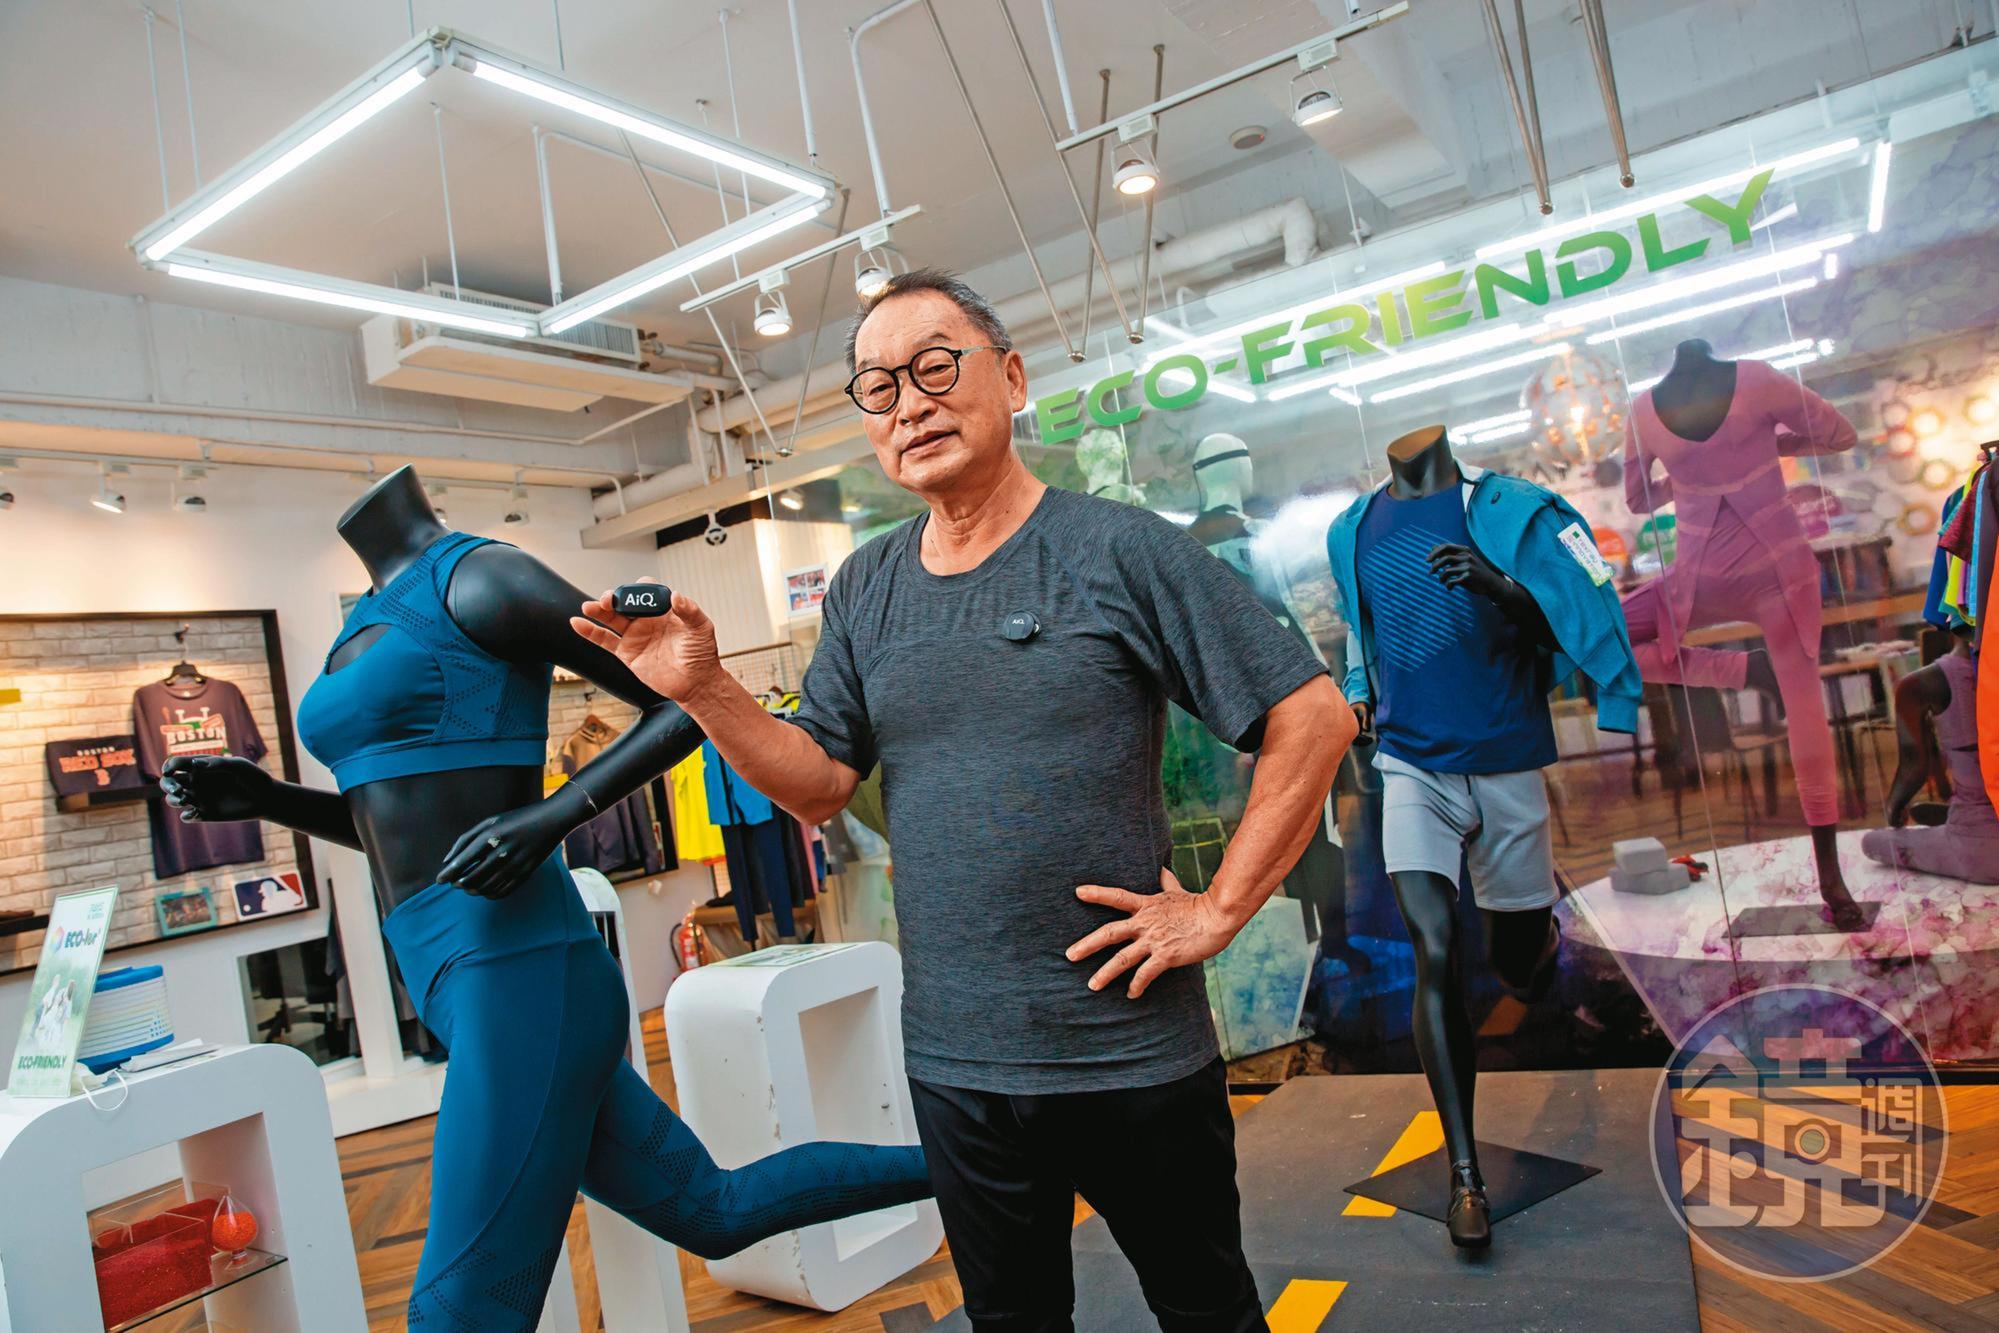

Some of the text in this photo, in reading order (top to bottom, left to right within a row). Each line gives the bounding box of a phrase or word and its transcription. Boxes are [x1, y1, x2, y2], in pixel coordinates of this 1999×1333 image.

[1035, 167, 1775, 444] ECO-FRIENDLY
[166, 726, 226, 744] BOSTON
[18, 1055, 67, 1070] ECO-FRIENDLY
